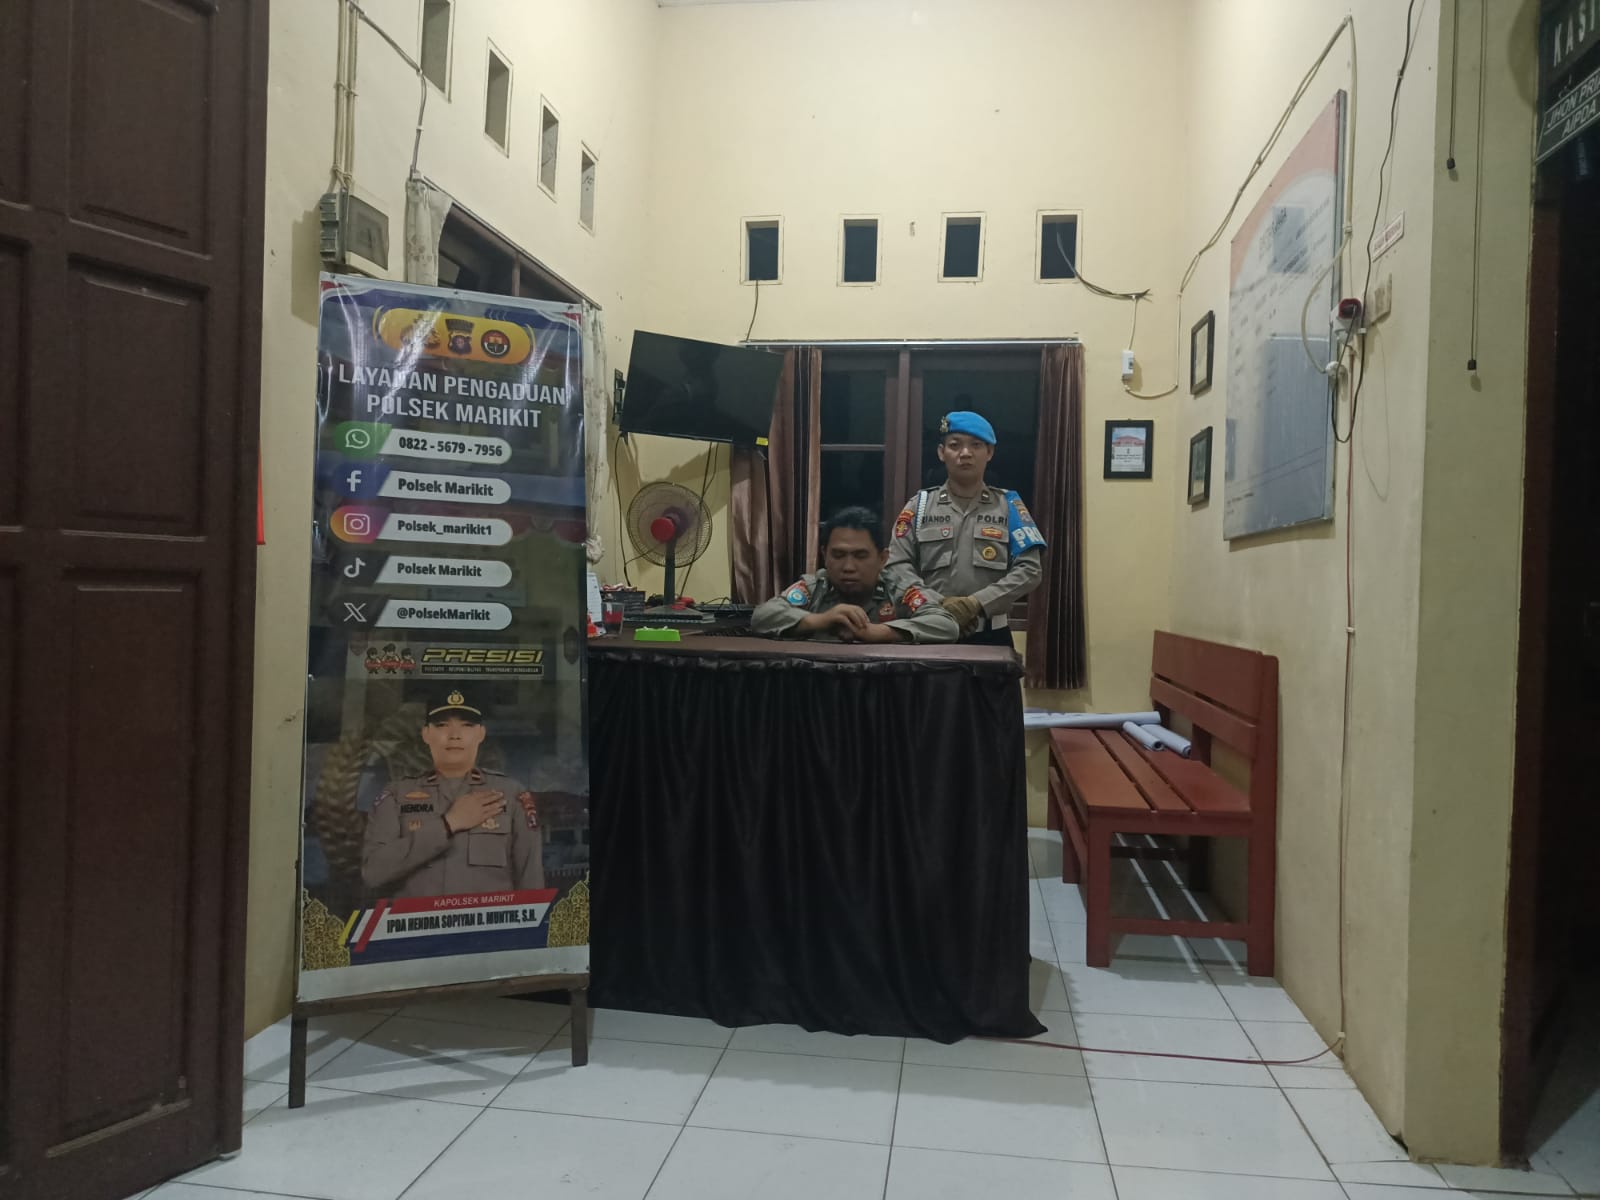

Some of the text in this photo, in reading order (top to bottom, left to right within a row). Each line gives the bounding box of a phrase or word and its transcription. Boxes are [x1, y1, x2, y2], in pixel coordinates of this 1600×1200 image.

[1561, 99, 1597, 138] AIPDA
[338, 363, 567, 405] LAYANAN PENGADUAN
[367, 394, 541, 428] POLSEK MARIKIT
[399, 436, 427, 451] 0822
[438, 440, 466, 454] 5679
[475, 444, 502, 457] 7956
[398, 478, 494, 497] Polsek Marikit
[397, 520, 492, 536] Polsek_marikit1
[977, 514, 1008, 526] POLRI
[397, 563, 482, 577] Polsek Marikit
[397, 607, 490, 621] @PolsekMarikit
[422, 648, 544, 663] PRESISI
[400, 803, 434, 814] HENDRA
[434, 894, 515, 908] KAPOLSEK MARIKIT
[386, 918, 407, 934] IPDA
[408, 915, 440, 931] HENDRA
[441, 912, 476, 929] SOPIYAN
[522, 908, 537, 922] S.H.
